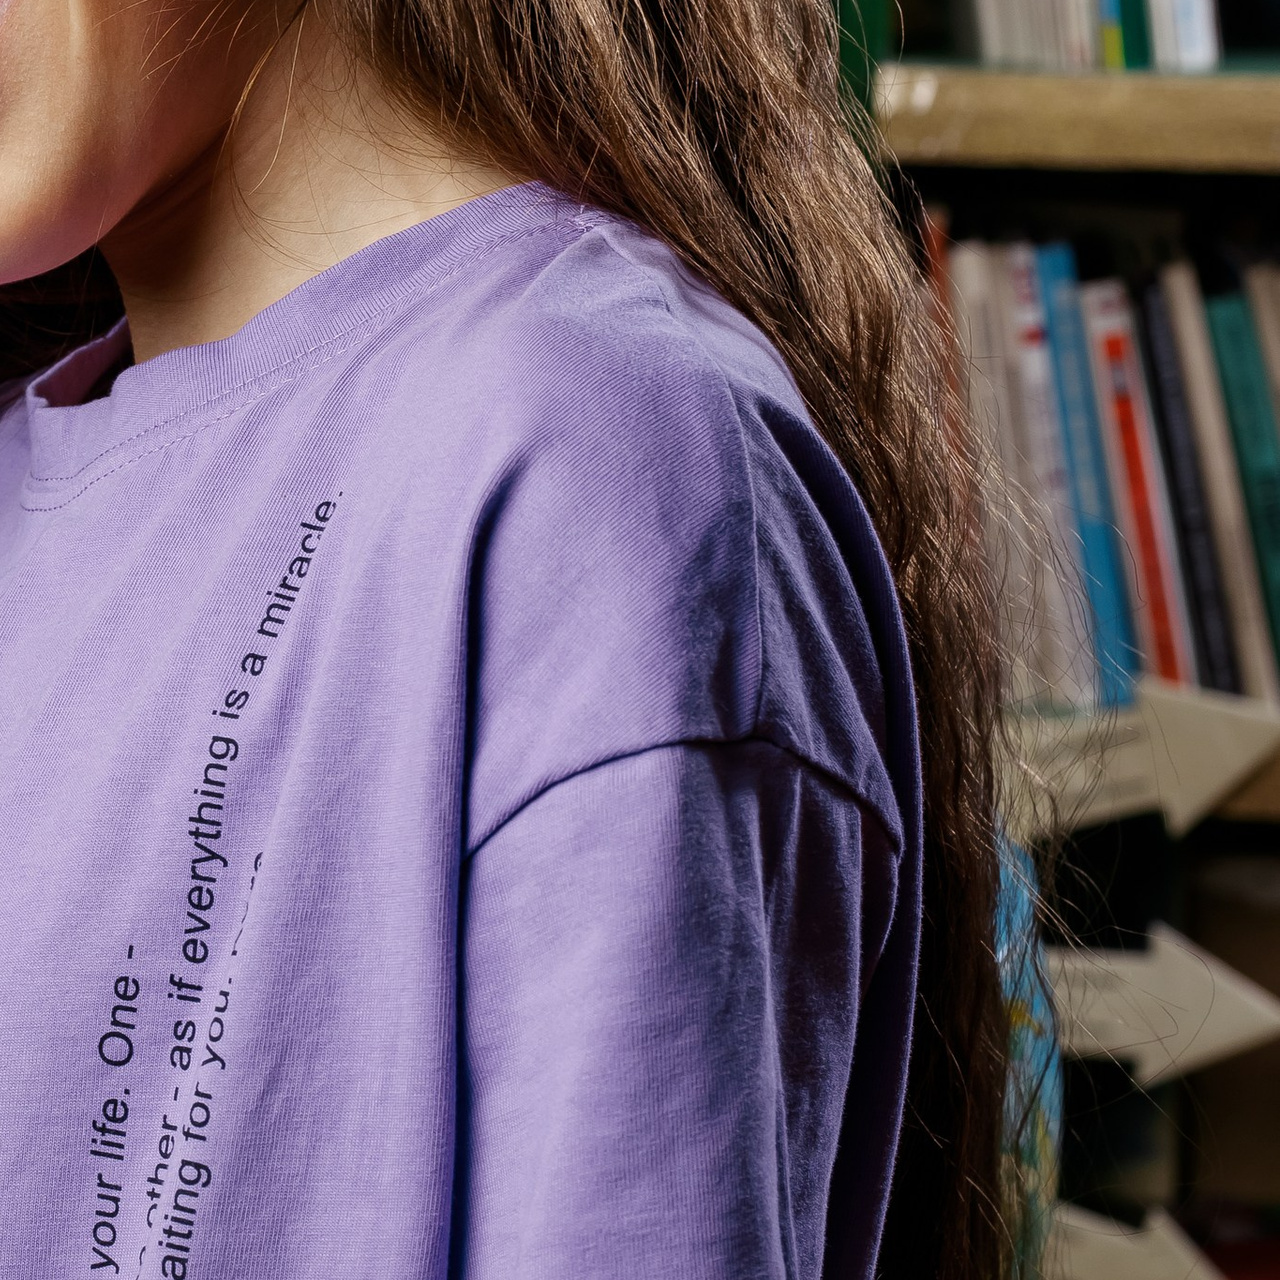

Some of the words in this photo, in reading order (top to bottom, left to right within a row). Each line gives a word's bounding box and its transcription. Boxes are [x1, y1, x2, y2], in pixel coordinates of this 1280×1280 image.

[241, 652, 268, 677] a
[212, 689, 250, 719] is
[182, 735, 239, 964] everything
[168, 974, 203, 1003] if
[98, 976, 140, 1067] One
[170, 1020, 196, 1071] as
[90, 1089, 130, 1161] life.
[182, 1081, 213, 1141] for
[91, 1173, 122, 1274] your
